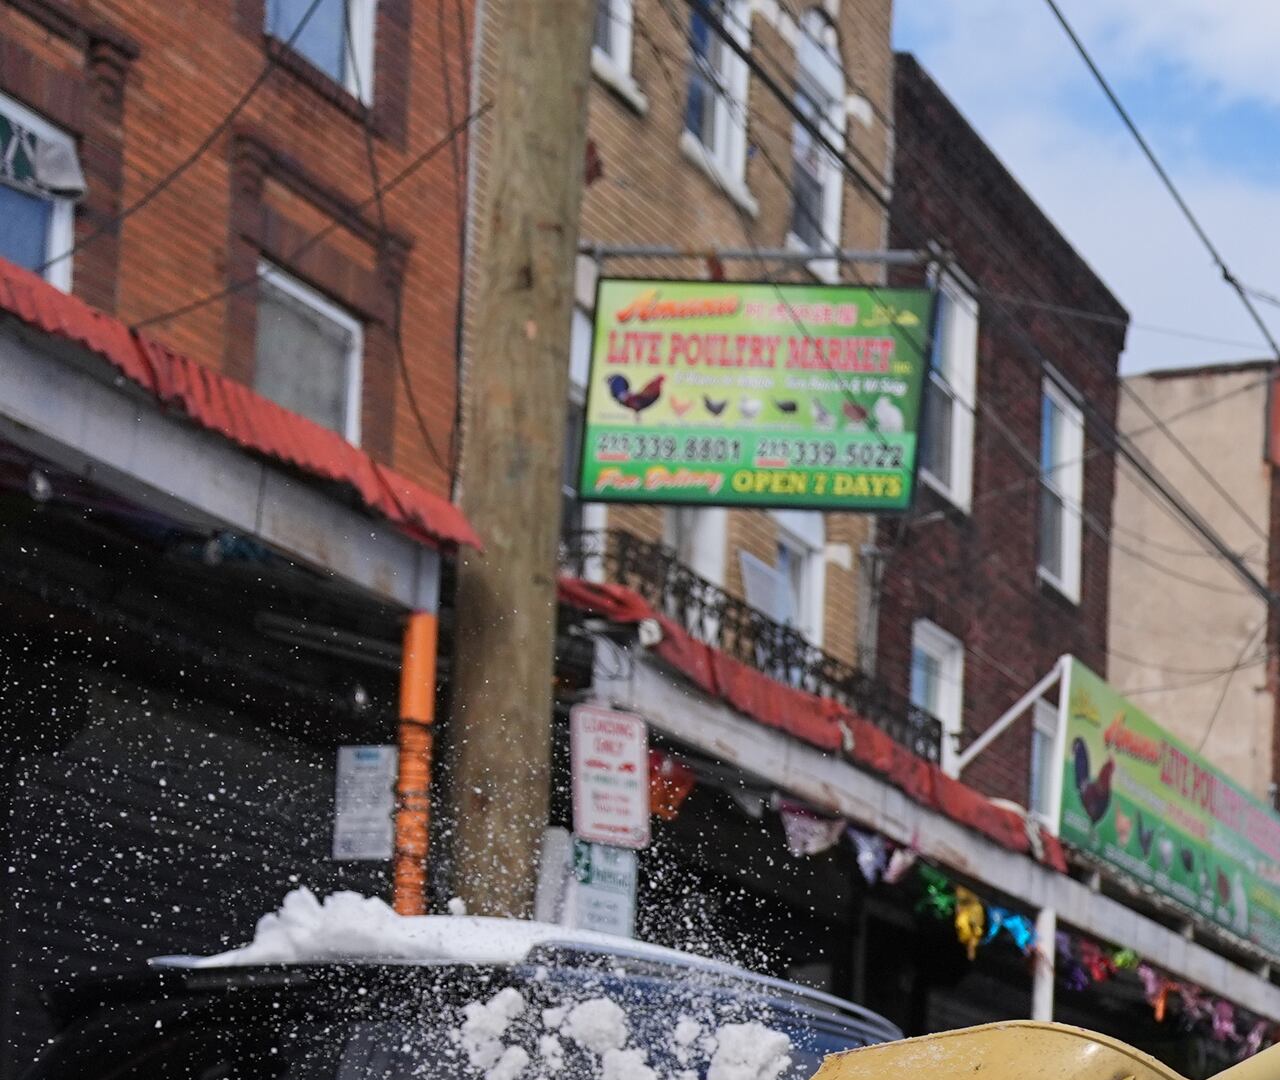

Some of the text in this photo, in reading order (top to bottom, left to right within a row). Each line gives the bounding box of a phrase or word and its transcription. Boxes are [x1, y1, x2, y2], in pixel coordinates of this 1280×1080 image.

[605, 329, 664, 367] LIVE
[667, 332, 782, 370] POULTRY
[785, 335, 896, 373] MARKET
[731, 468, 808, 495] OPEN
[813, 472, 827, 496] 7
[832, 472, 902, 498] DAYS
